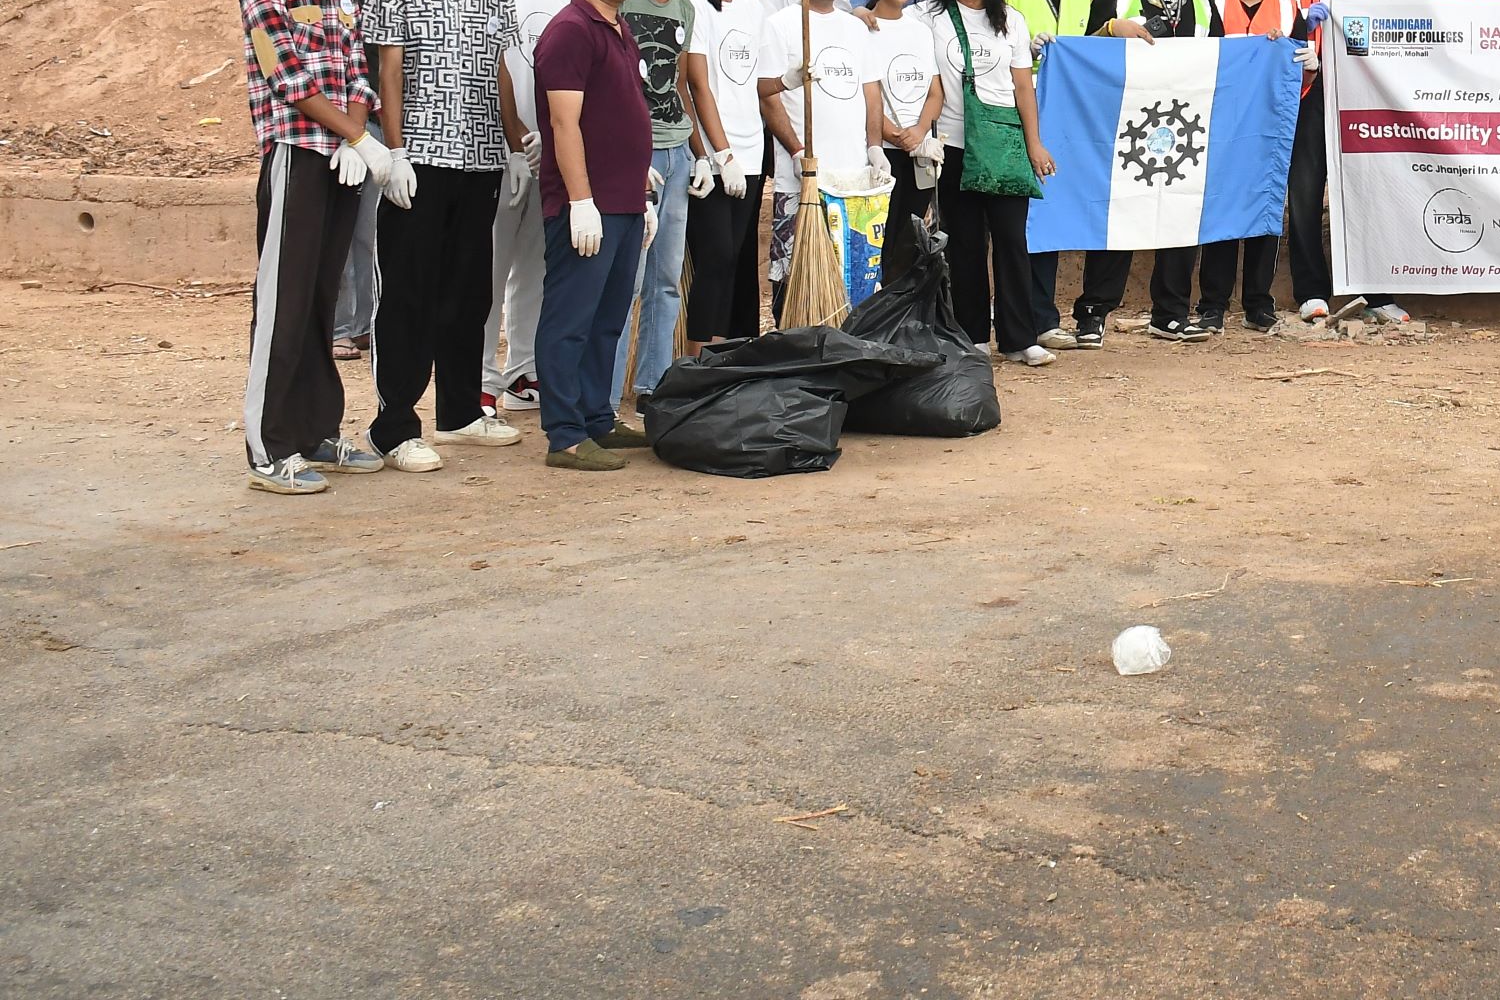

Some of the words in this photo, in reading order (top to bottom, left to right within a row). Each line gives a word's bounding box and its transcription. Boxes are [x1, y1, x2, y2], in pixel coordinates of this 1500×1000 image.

[1371, 18, 1433, 30] CHANDIGARH
[1347, 37, 1365, 46] CGC
[1371, 31, 1404, 43] GROUP
[1406, 31, 1418, 43] OF
[1419, 31, 1464, 43] COLLEGES
[896, 66, 924, 82] irada
[1413, 89, 1451, 101] Small
[1454, 89, 1493, 104] Steps,
[1348, 122, 1492, 146] “Sustainability
[1411, 163, 1434, 173] CGC
[1435, 164, 1476, 177] Jhanjeri
[1478, 166, 1488, 175] In
[1433, 207, 1472, 224] irada
[1391, 265, 1401, 275] Is
[1402, 265, 1438, 277] Paving
[1441, 265, 1458, 275] the
[1461, 265, 1485, 277] Way
